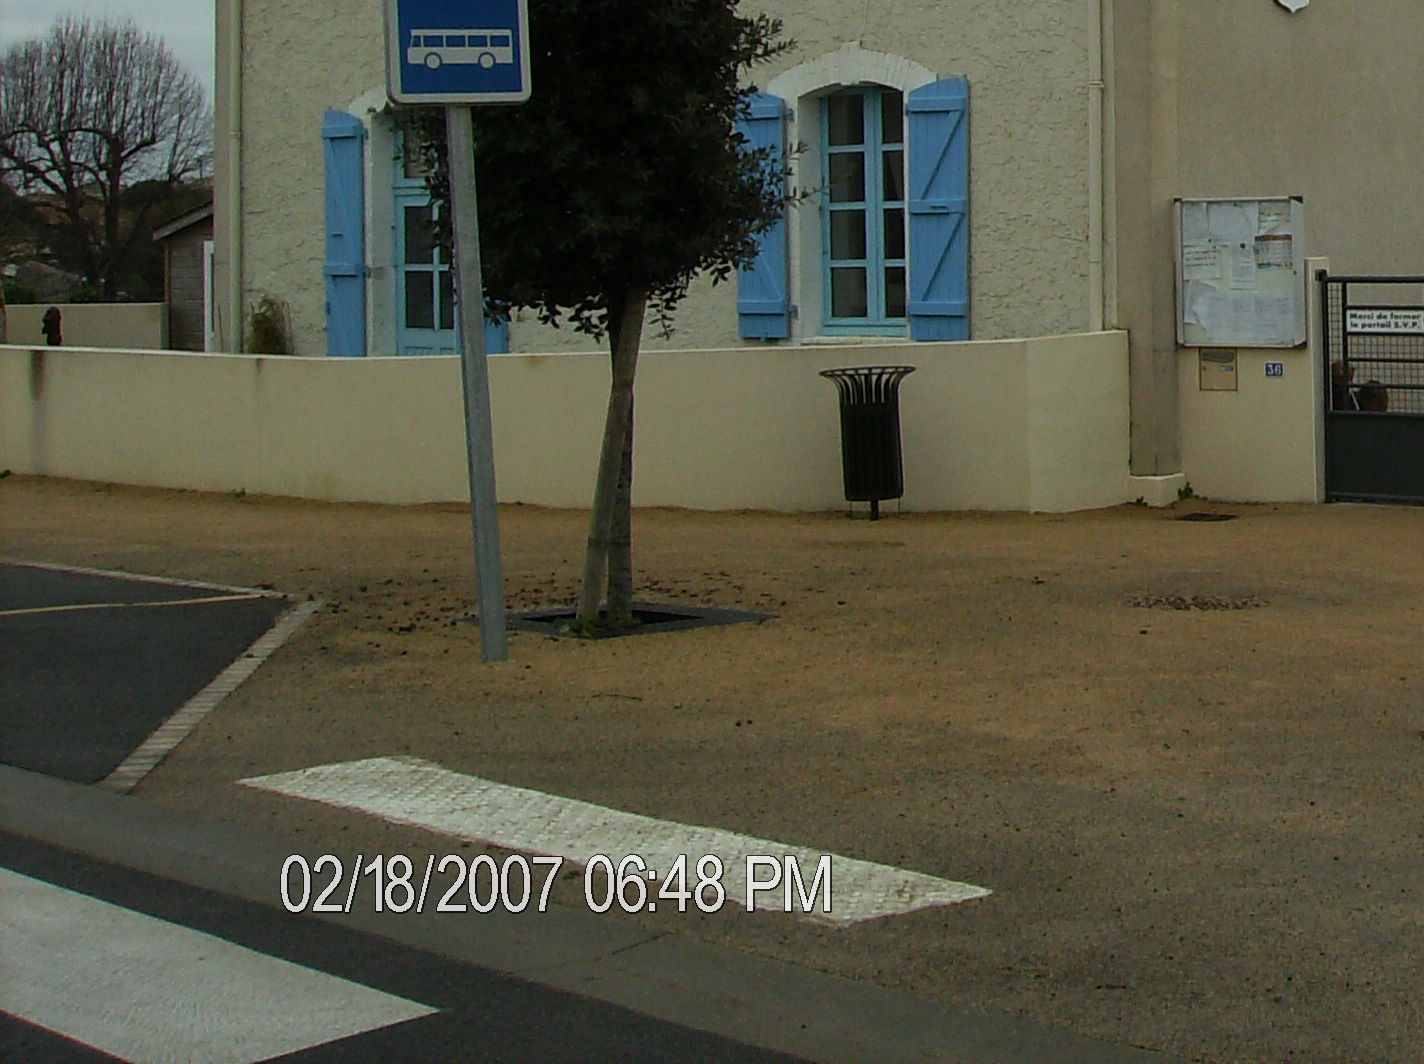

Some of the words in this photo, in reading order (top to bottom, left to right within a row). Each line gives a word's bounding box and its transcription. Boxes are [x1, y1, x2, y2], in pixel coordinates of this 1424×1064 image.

[1349, 312, 1374, 320] Merci
[1376, 312, 1388, 320] de
[1390, 312, 1421, 320] fermer
[1350, 321, 1359, 329] le
[1360, 320, 1391, 330] portail
[1394, 321, 1421, 329] S.V.P.
[1267, 364, 1282, 376] 36
